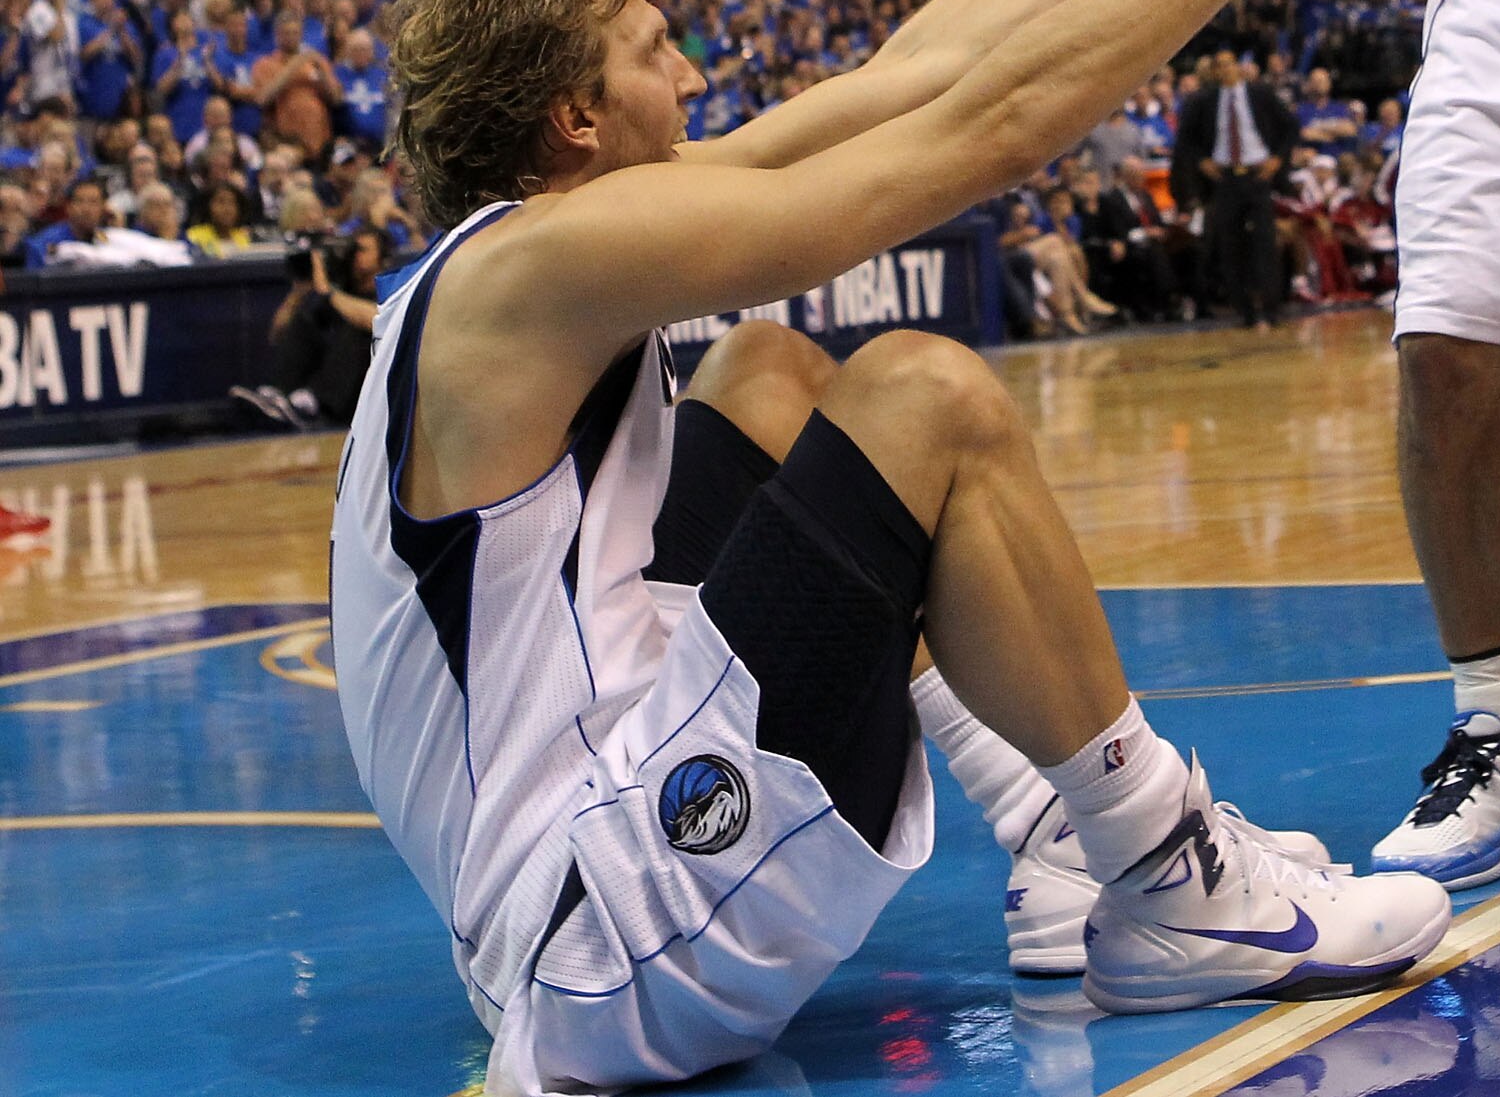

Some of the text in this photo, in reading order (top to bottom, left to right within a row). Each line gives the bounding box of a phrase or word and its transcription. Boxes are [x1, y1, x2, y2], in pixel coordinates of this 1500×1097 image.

[832, 254, 900, 329] NBA
[901, 249, 945, 321] TV
[69, 302, 149, 402] TV
